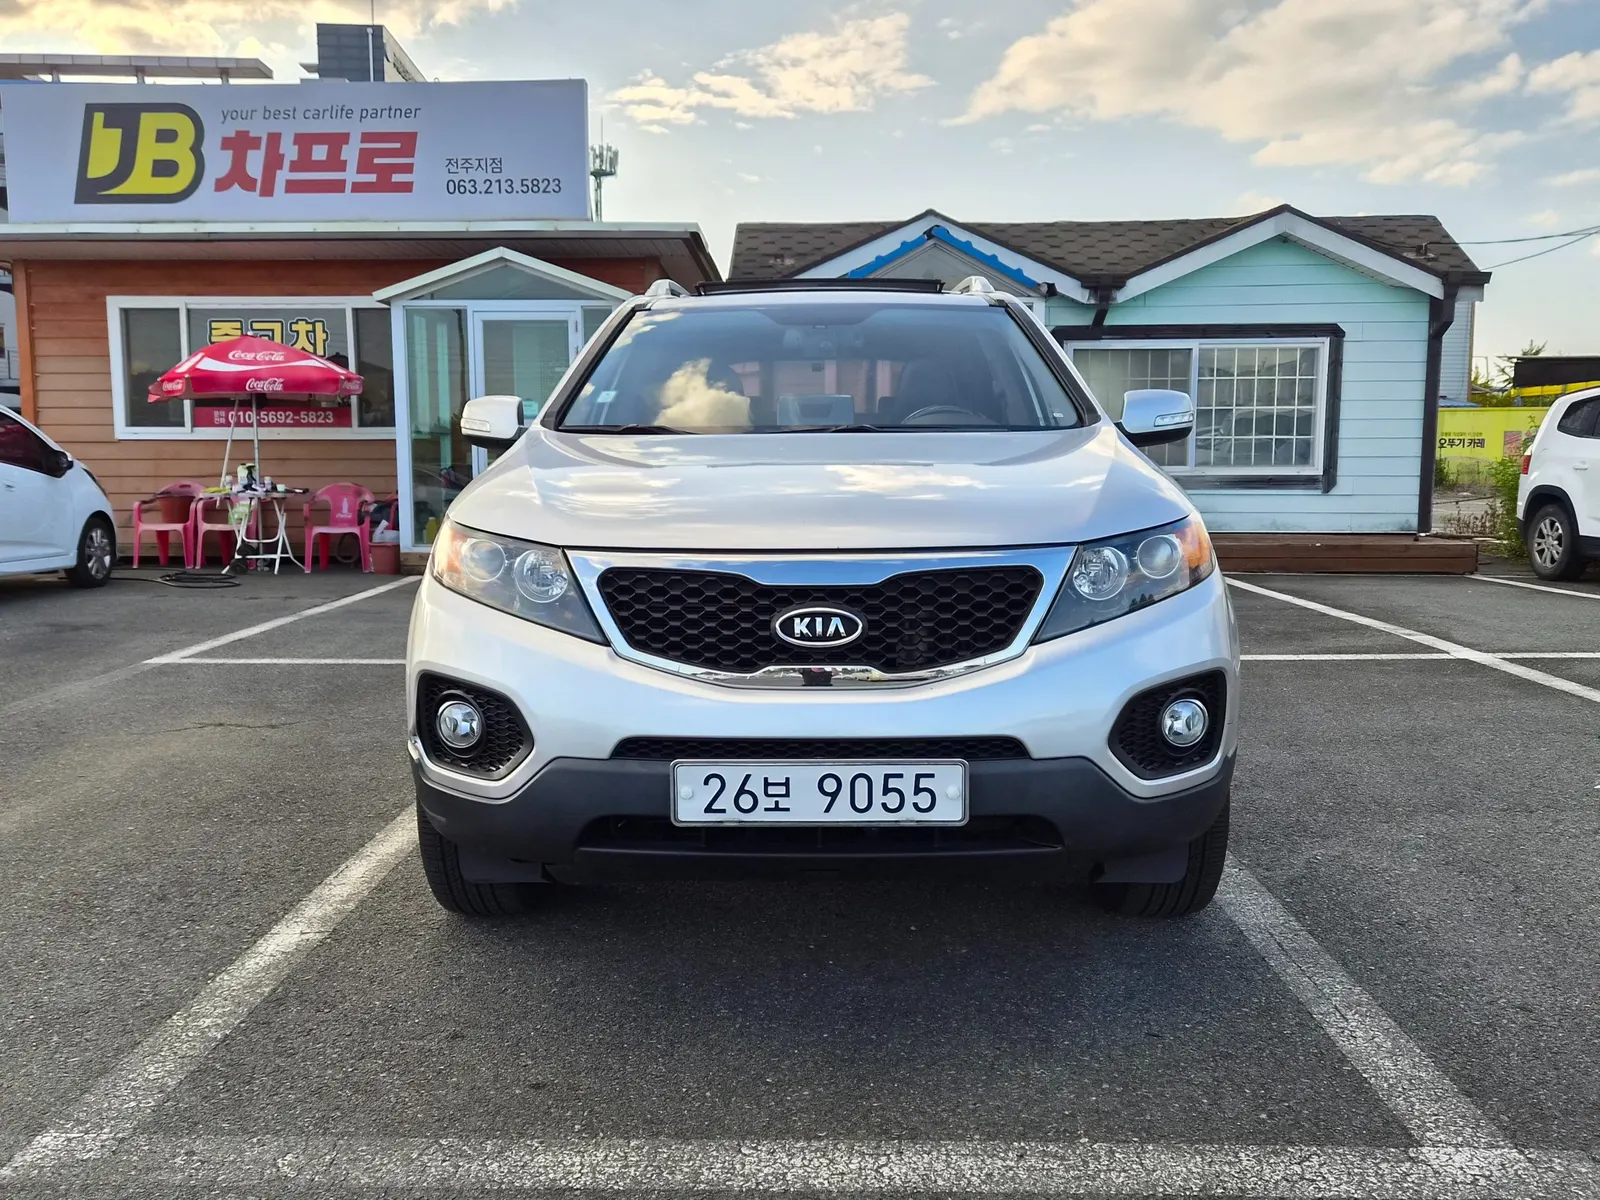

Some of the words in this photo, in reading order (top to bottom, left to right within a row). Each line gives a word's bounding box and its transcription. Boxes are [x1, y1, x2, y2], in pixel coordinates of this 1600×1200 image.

[220, 108, 257, 124] your
[262, 105, 297, 120] best
[303, 104, 354, 120] carlife
[359, 105, 422, 123] partner
[213, 130, 418, 198] 차프로
[445, 157, 503, 174] 전주지점
[446, 178, 562, 195] 063.213.5823
[1438, 438, 1465, 448] 오뚜기
[1466, 438, 1485, 448] 카레
[793, 617, 847, 638] KIA
[702, 772, 791, 814] 26보
[816, 772, 937, 814] 9055
